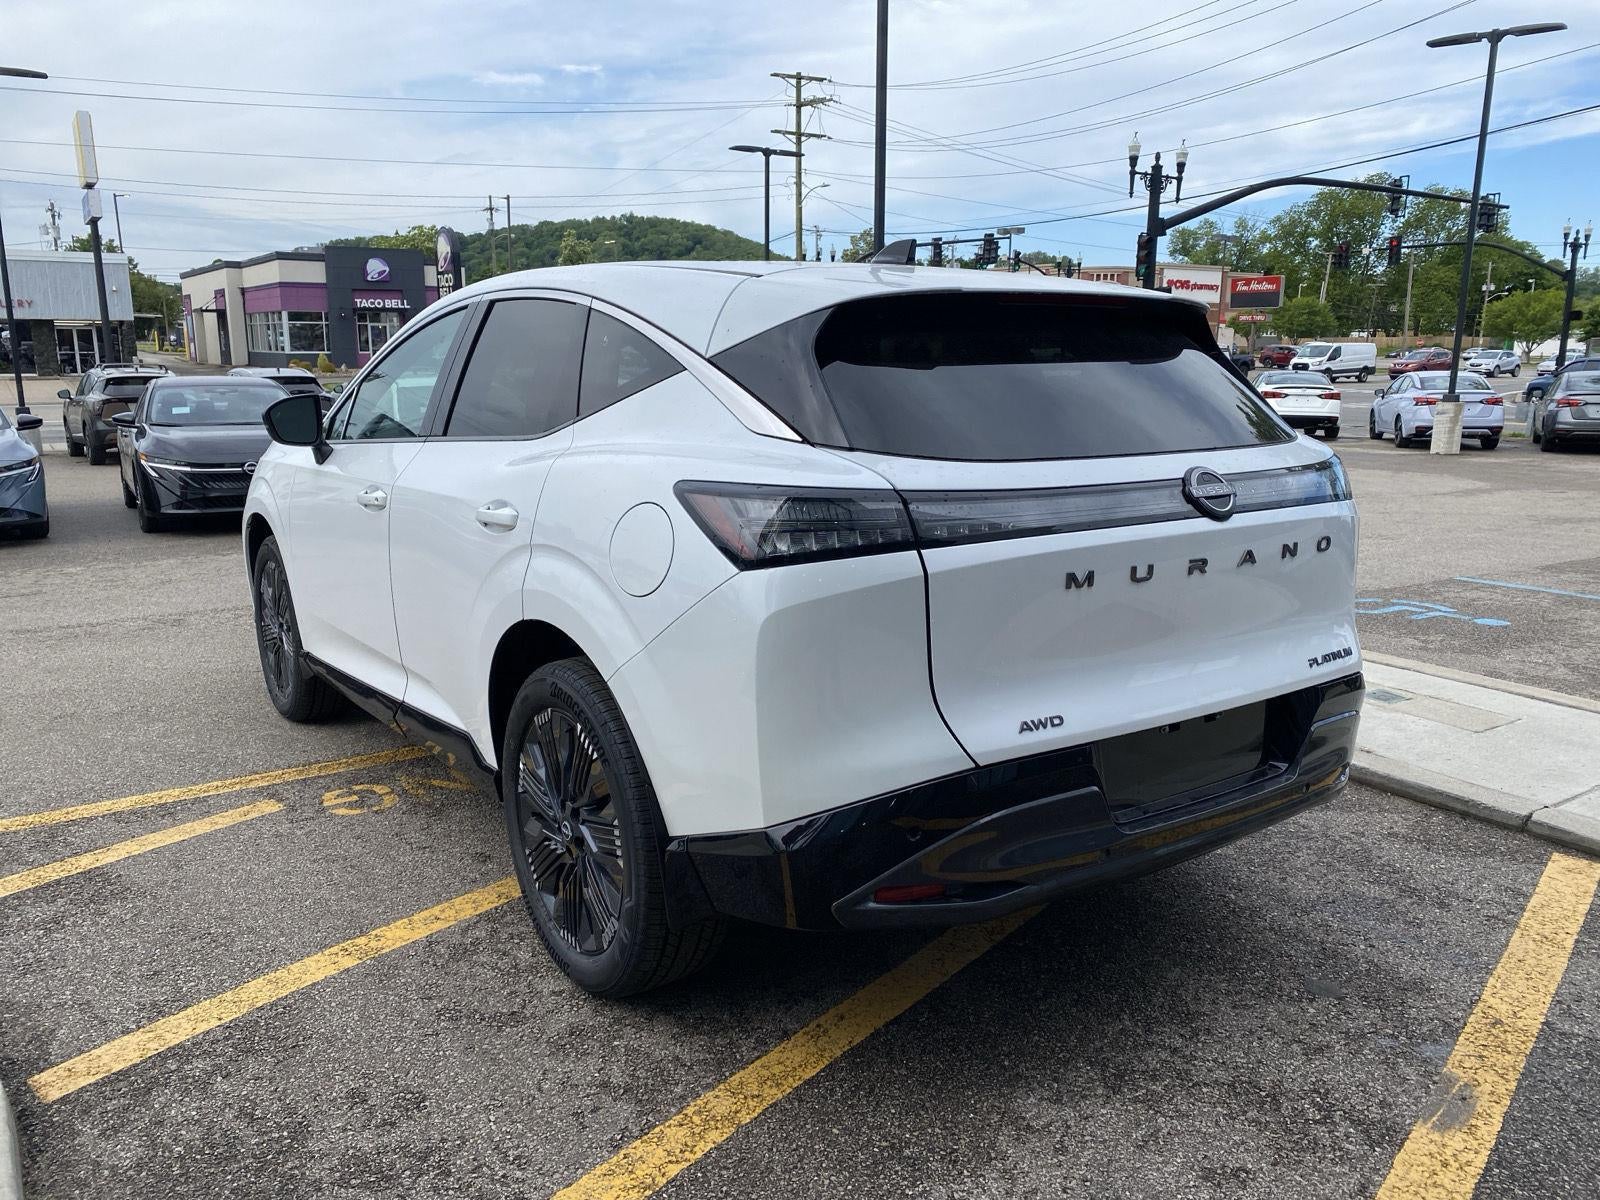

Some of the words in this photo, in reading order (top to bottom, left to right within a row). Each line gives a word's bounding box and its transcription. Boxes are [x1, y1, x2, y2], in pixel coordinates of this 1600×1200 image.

[437, 273, 453, 287] TACO
[1174, 279, 1191, 290] CVS
[1191, 282, 1219, 292] pharmacy
[1236, 281, 1249, 292] Tim
[1249, 279, 1276, 293] Hortons
[354, 298, 383, 308] TACO
[385, 299, 410, 309] BELL
[1064, 535, 1332, 590] MURANO
[1307, 646, 1353, 669] PLATINUM
[1018, 714, 1064, 735] AWD
